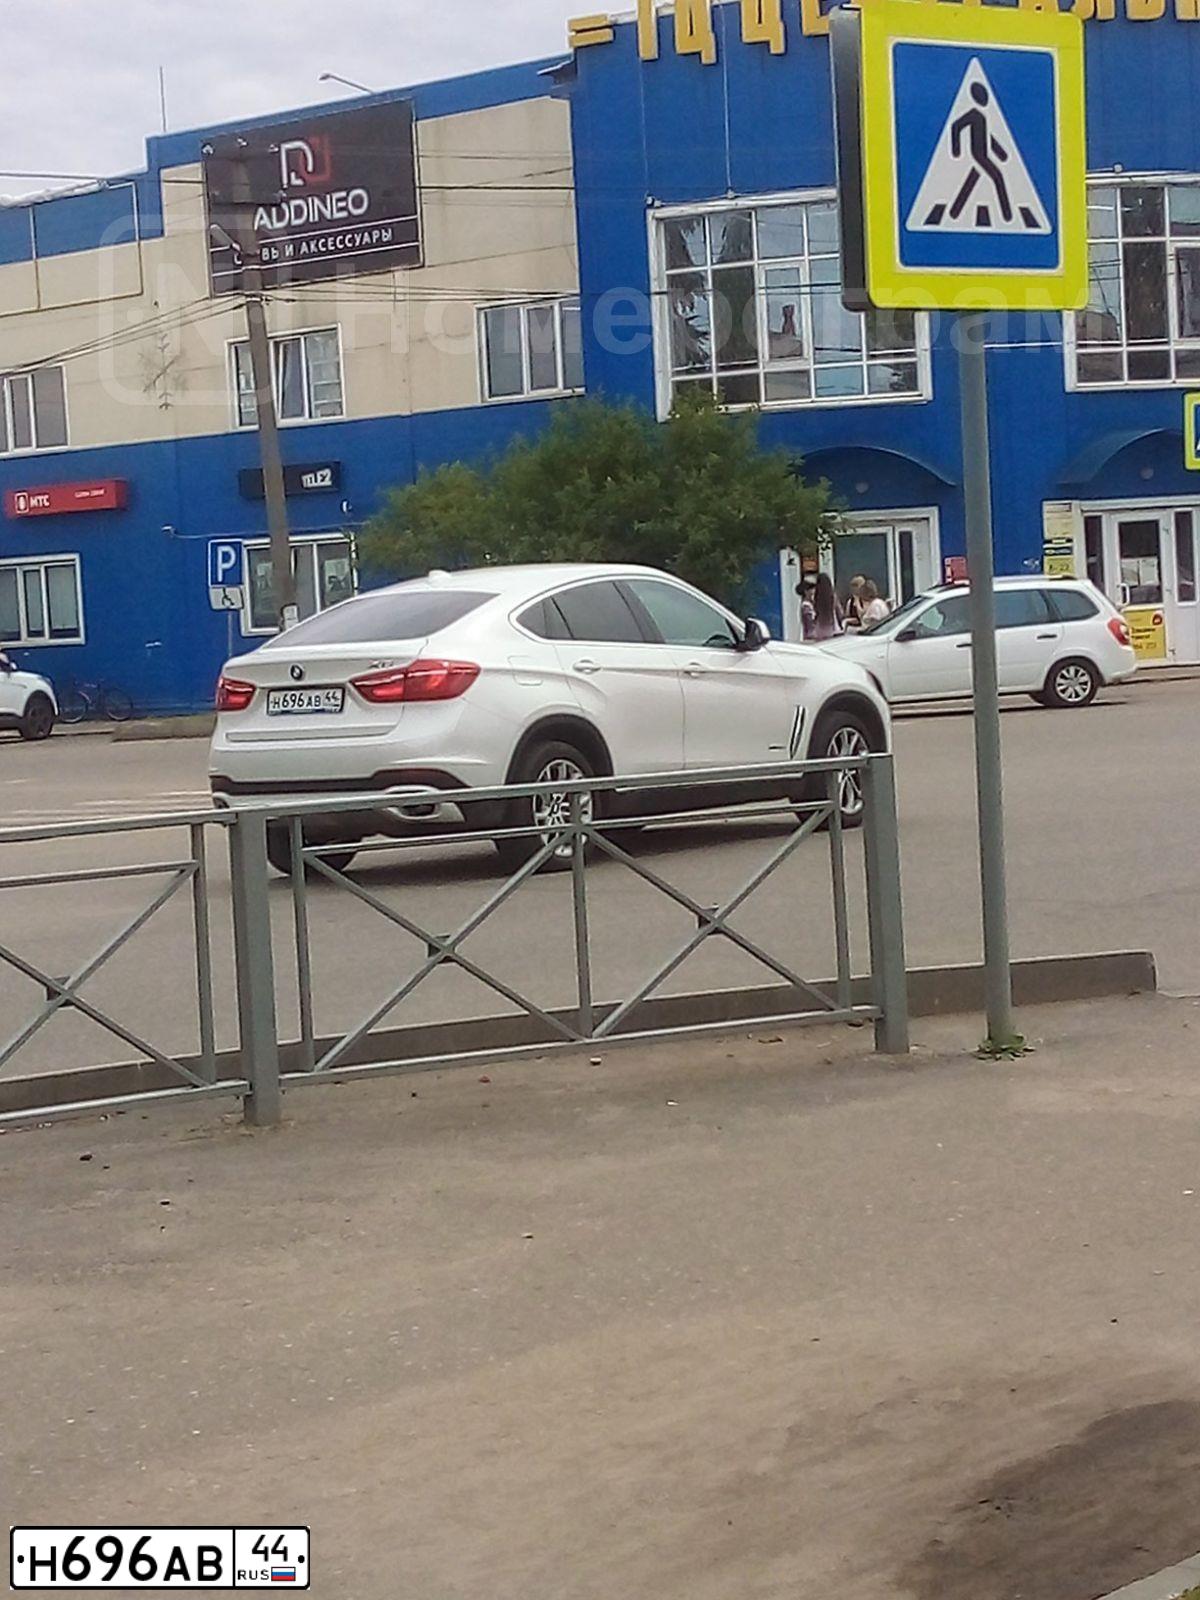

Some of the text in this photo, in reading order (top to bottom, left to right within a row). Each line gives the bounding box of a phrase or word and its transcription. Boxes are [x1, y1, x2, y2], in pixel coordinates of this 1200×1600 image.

[254, 188, 370, 231] ADDINEO
[284, 241, 295, 257] И
[300, 227, 393, 256] АКСЕССУАРЫ
[217, 545, 236, 582] P
